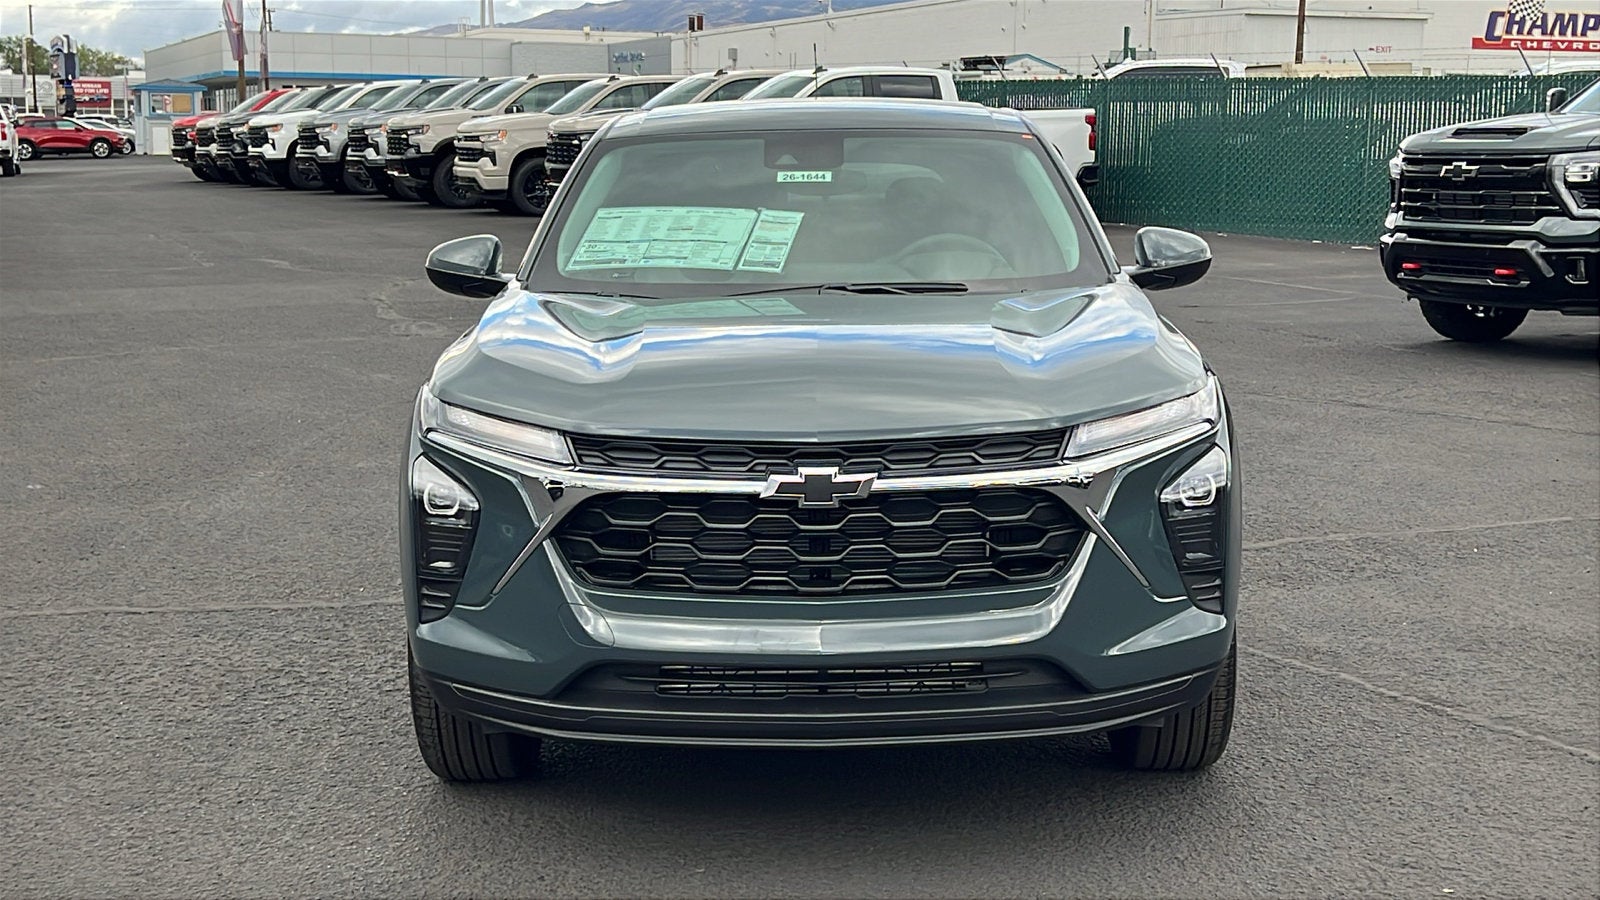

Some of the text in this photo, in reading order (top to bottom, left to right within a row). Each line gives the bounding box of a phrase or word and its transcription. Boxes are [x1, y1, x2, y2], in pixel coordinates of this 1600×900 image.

[1484, 10, 1600, 42] CHAMP
[1375, 45, 1392, 54] EXIT
[782, 173, 826, 181] 26-1644
